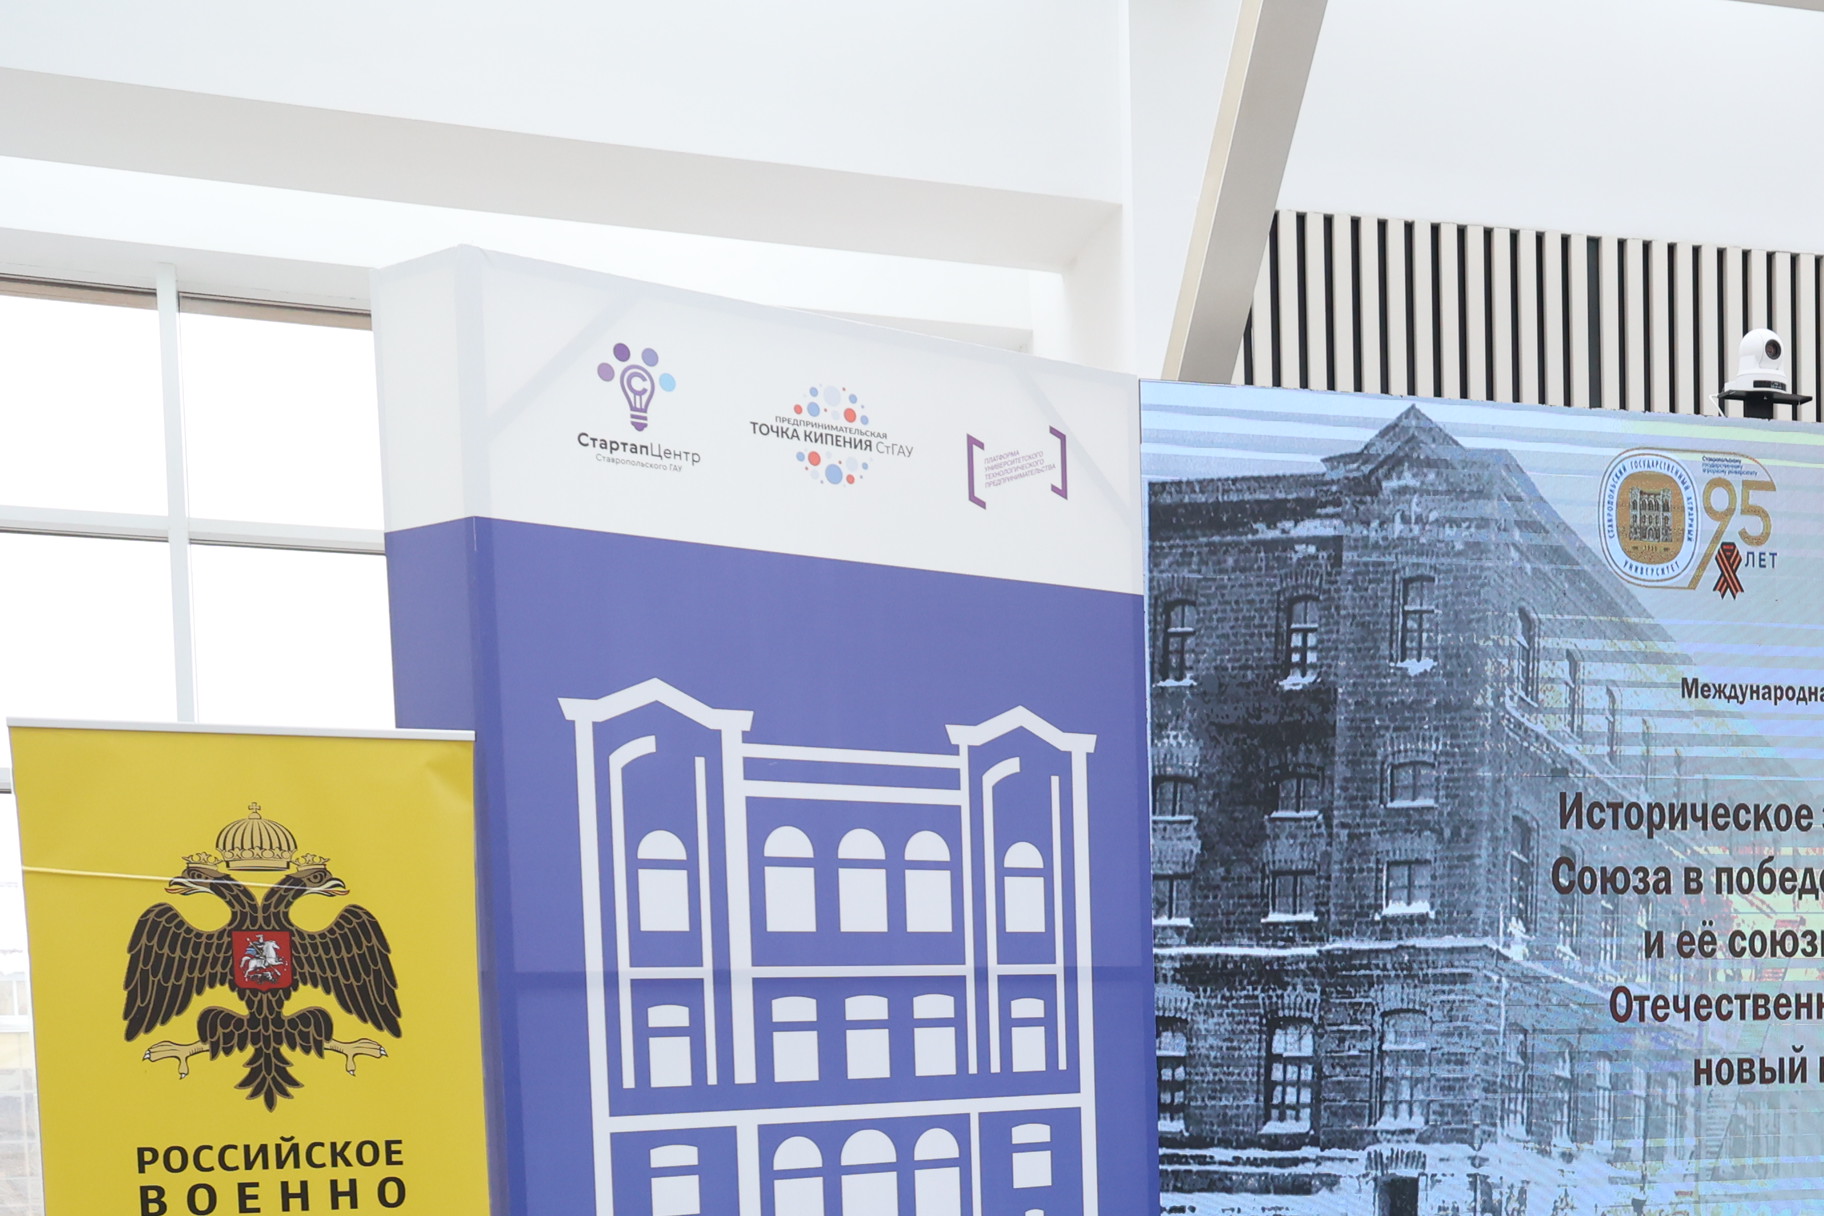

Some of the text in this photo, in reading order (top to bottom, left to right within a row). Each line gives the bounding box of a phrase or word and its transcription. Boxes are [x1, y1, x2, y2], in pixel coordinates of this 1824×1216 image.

[750, 421, 914, 458] ТОЧКА КИПЕНИЯ СтГАУ
[775, 416, 887, 439] ПРЕДПРИНИМАТЕЛЬСКАЯ
[577, 432, 701, 466] СтартапЦентр
[595, 453, 683, 472] Ставропольского ГАУ
[984, 450, 1019, 464] ПЛАТФОРМА
[1688, 477, 1776, 590] 95
[1623, 559, 1680, 577] УНИВЕРСИТЕТ
[1745, 551, 1777, 569] ЛЕТ
[1558, 791, 1814, 839] Историческое
[1552, 856, 1671, 895] Союза
[1684, 866, 1704, 894] в
[1645, 929, 1664, 959] и
[1676, 920, 1717, 959] её
[1693, 1045, 1807, 1086] новый
[136, 1135, 404, 1174] РОССИЙСКОЕ
